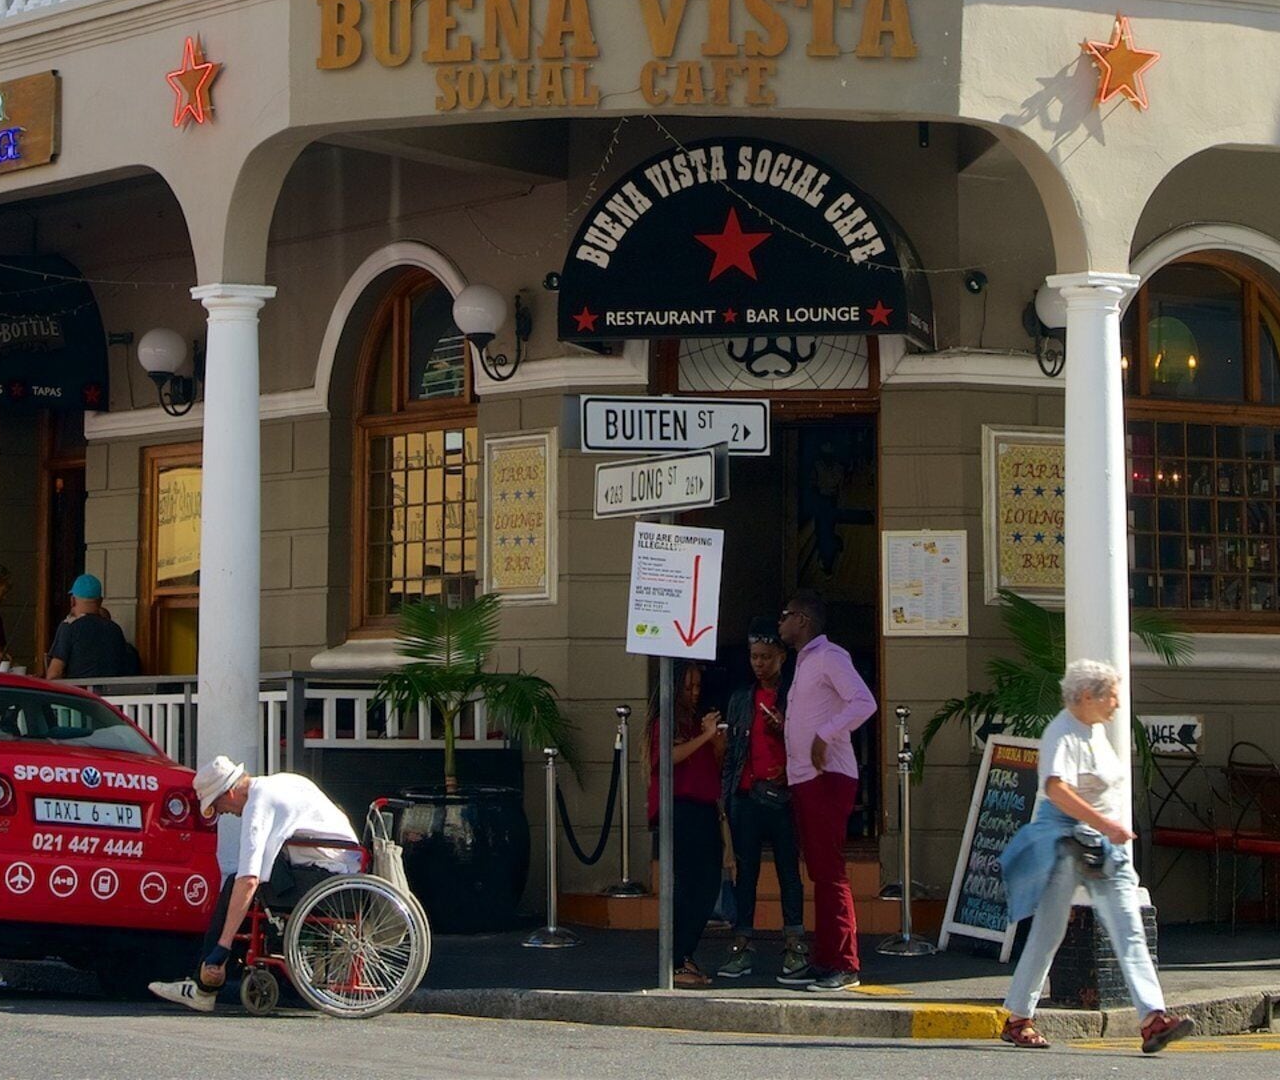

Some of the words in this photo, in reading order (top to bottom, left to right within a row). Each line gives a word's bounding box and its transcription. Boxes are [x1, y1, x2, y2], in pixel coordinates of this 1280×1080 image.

[434, 62, 601, 112] SOCIAL
[639, 59, 777, 107] CAFE
[576, 181, 653, 270] BUENA
[644, 146, 728, 199] VISTA
[737, 146, 831, 209] SOCIAL
[824, 192, 887, 264] CAFE
[605, 309, 717, 326] RESTAURANT
[746, 308, 780, 324] BAR
[786, 306, 860, 322] LOUNGE
[0, 319, 61, 344] BOTTLE
[32, 385, 63, 397] TAPAS
[605, 409, 688, 441] BUITEN
[697, 410, 715, 430] ST
[731, 423, 740, 442] 2
[1011, 463, 1065, 479] TAPA
[630, 468, 663, 502] LONG
[667, 466, 677, 485] ST
[1004, 508, 1065, 529] LOUNG
[639, 532, 656, 541] YOU
[656, 533, 673, 543] ARE
[674, 535, 713, 547] DUMPING
[1022, 553, 1061, 570] BAR
[14, 764, 81, 784] SPORT
[104, 772, 160, 792] TAXIS
[990, 770, 1020, 788] TAPAS
[43, 800, 82, 821] TAXI
[91, 807, 101, 821] 6
[115, 807, 134, 825] WP
[32, 832, 63, 851] 021
[68, 835, 101, 854] 447
[103, 839, 144, 858] 4444
